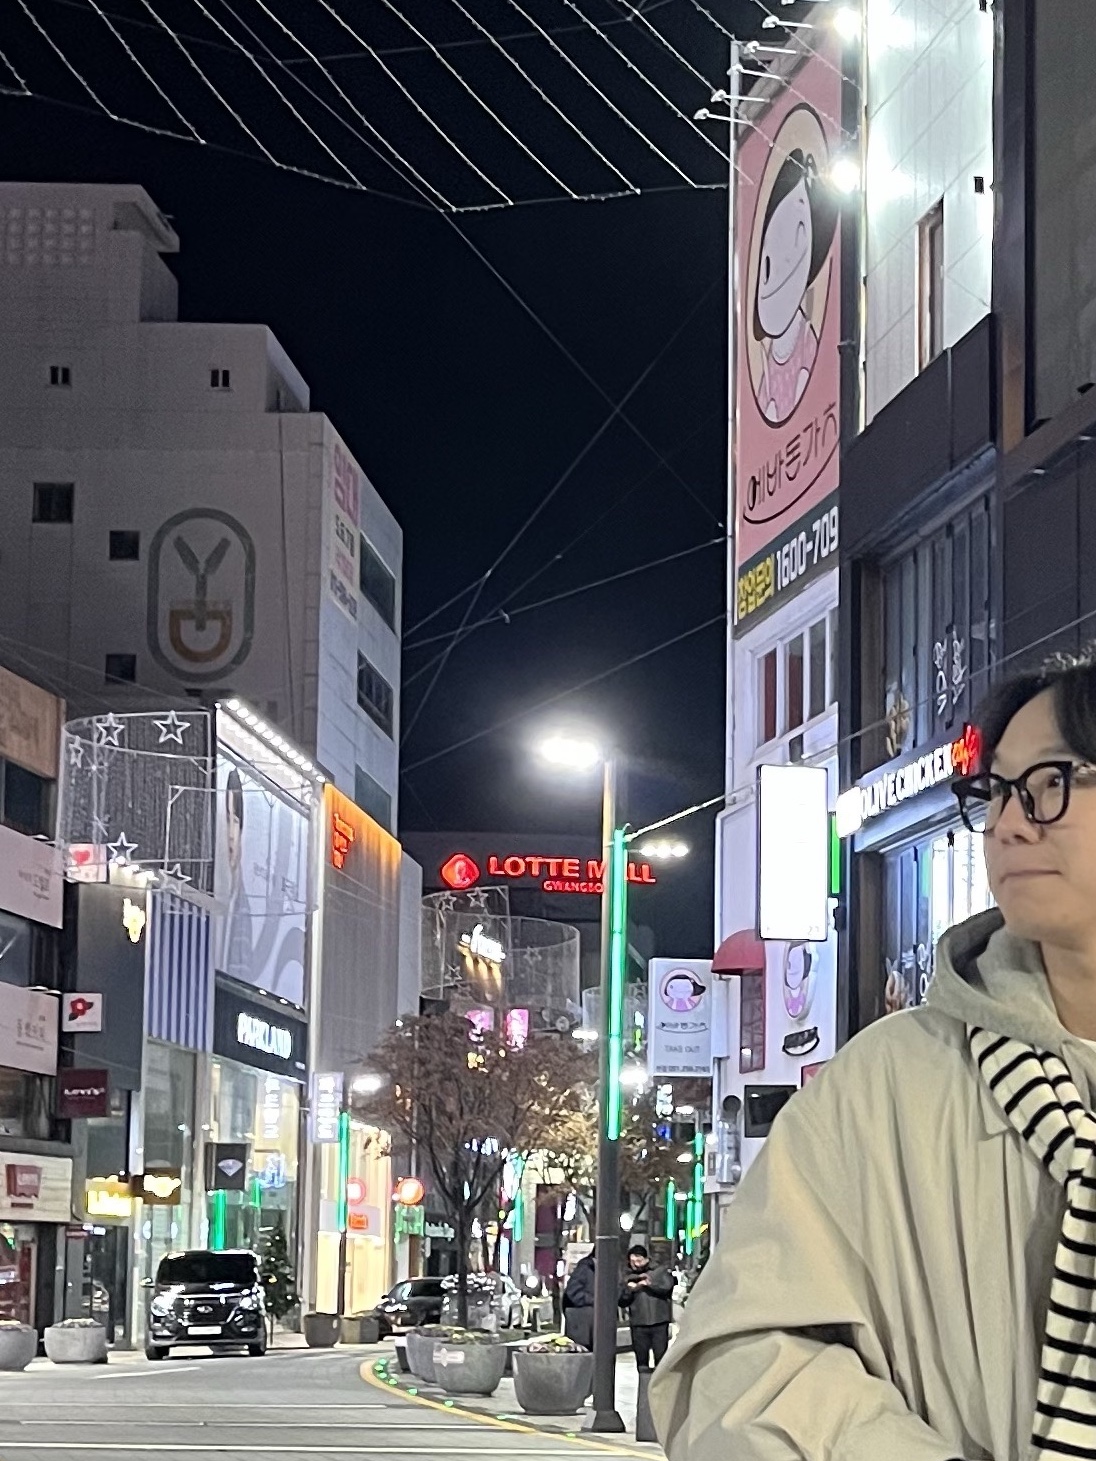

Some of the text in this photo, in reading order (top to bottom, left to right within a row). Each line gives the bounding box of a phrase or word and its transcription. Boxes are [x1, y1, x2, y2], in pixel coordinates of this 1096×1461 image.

[776, 506, 839, 591] 1600-709
[895, 742, 954, 802] CHICKEN
[489, 856, 657, 883] LOTTE MLL
[543, 880, 605, 894] GWANGBO
